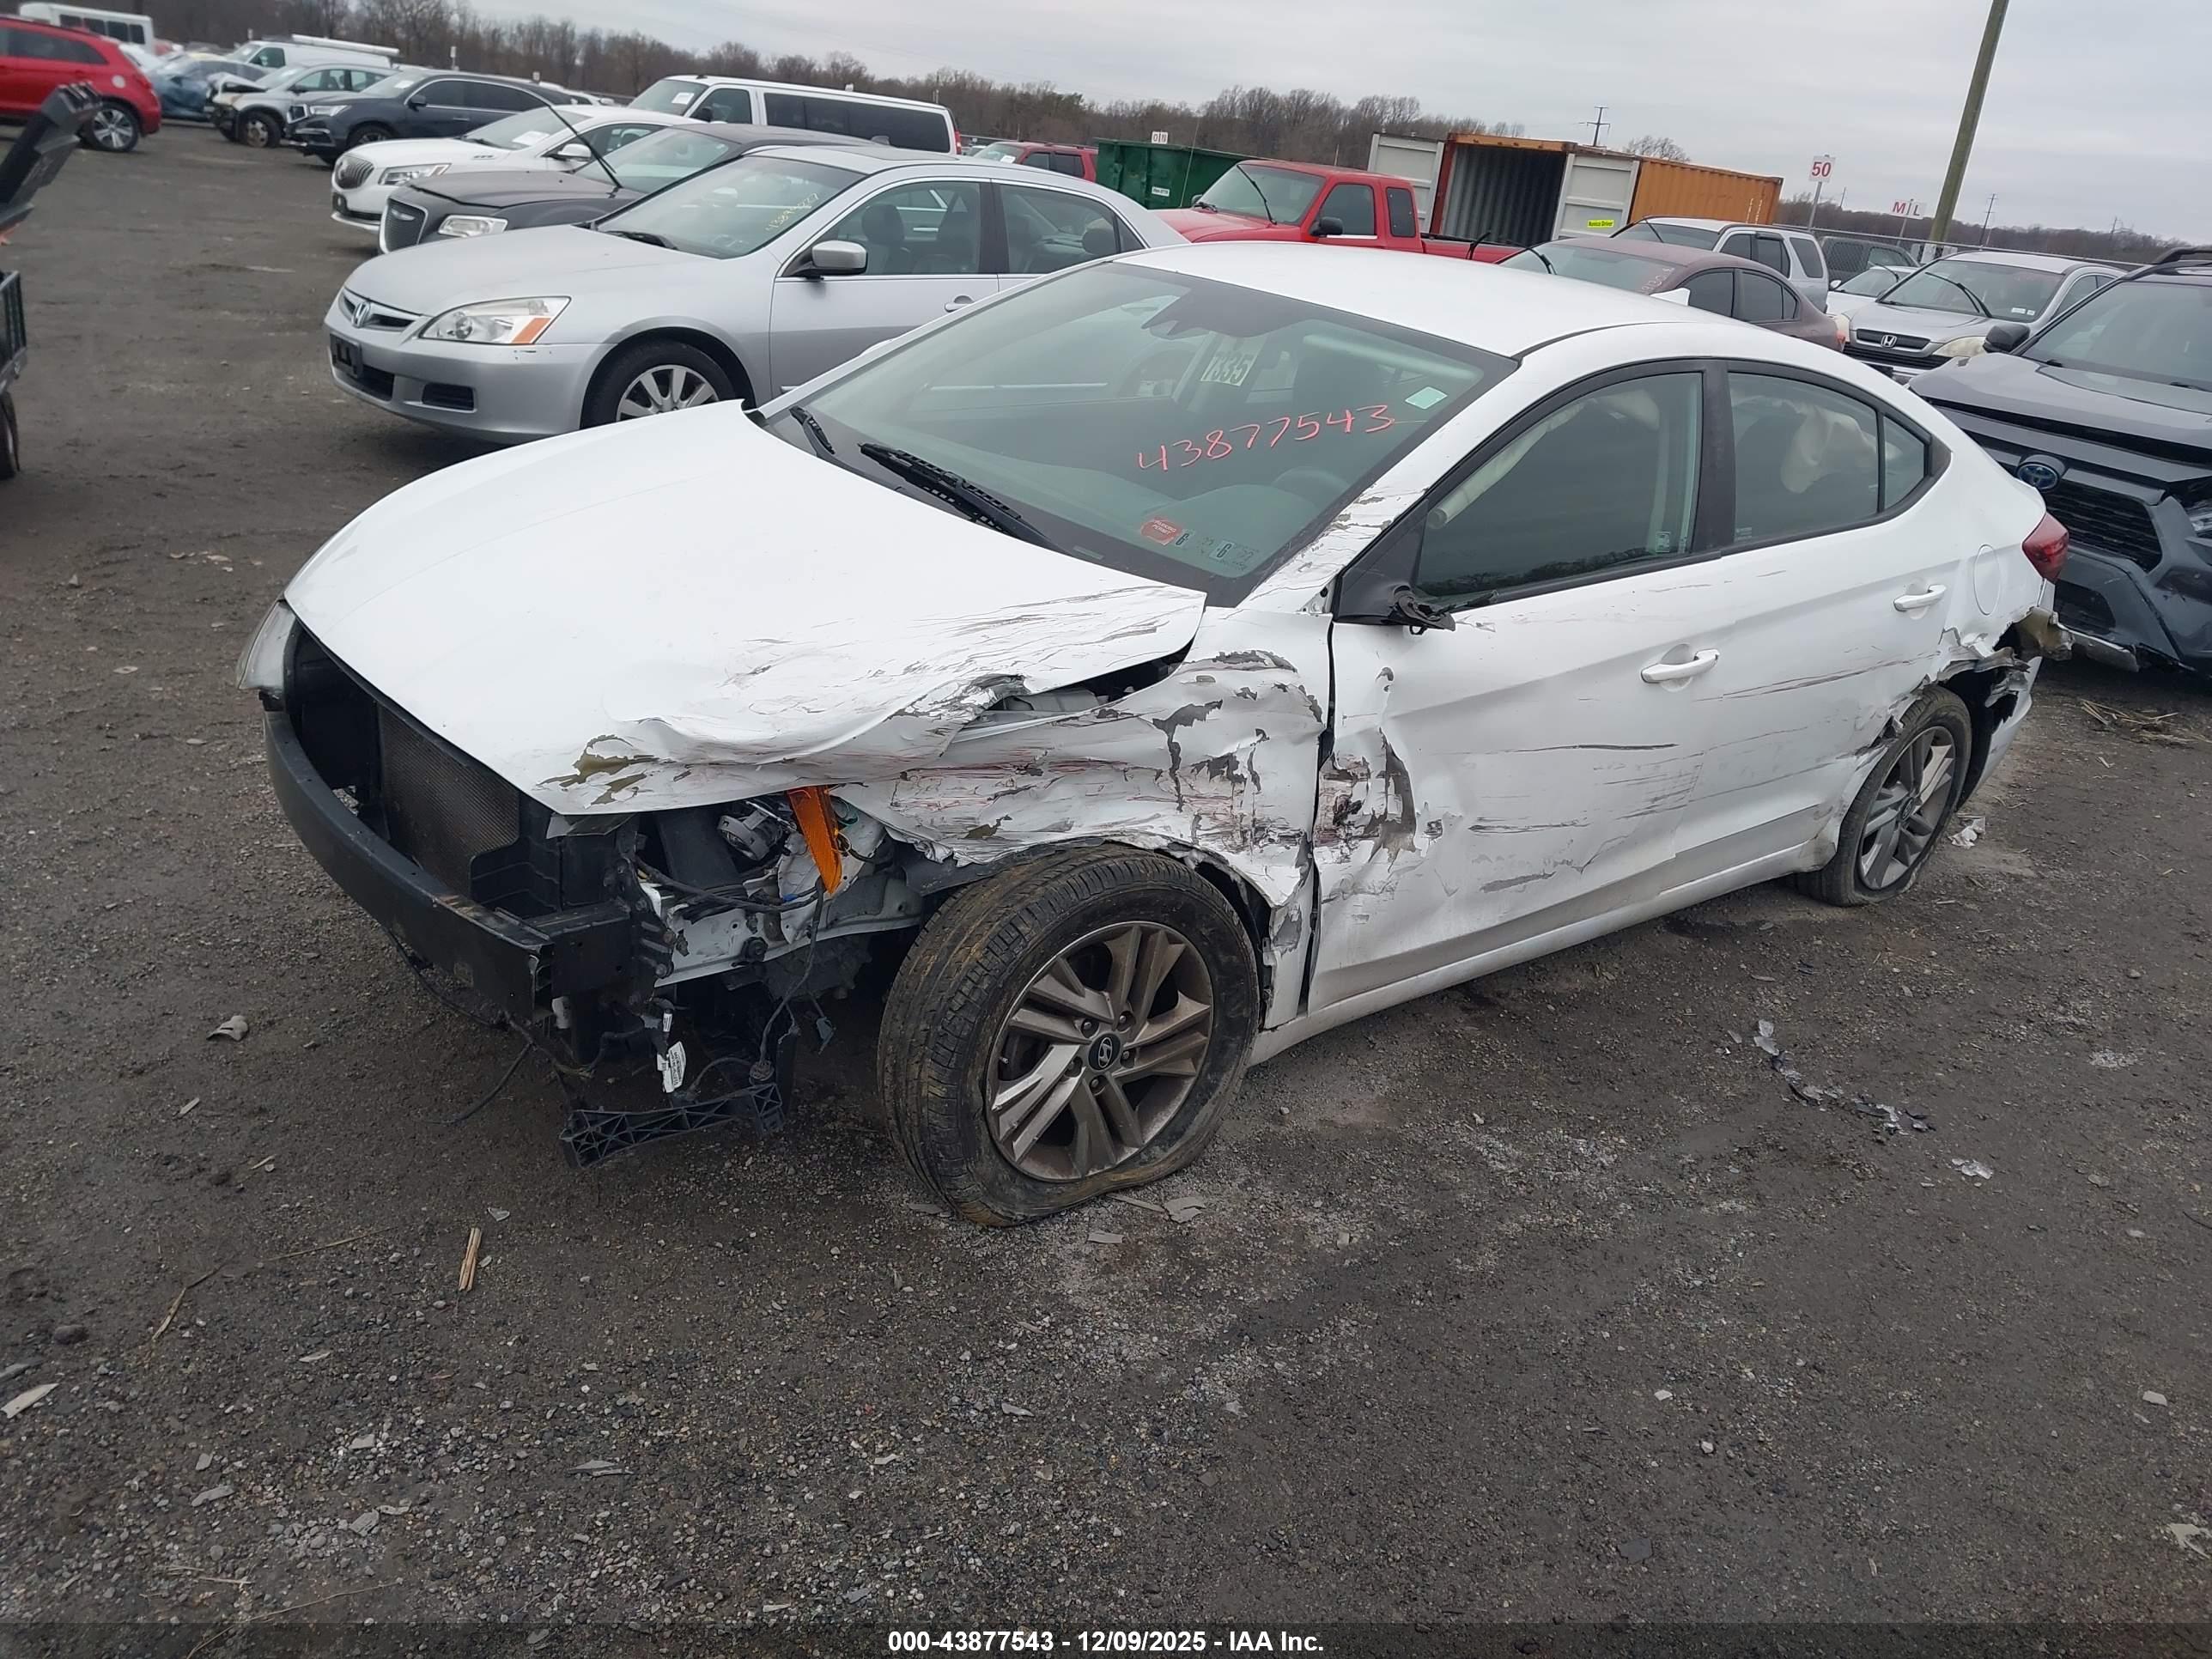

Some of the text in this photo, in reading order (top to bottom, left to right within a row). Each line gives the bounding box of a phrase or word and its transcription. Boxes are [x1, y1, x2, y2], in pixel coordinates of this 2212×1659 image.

[1811, 161, 1832, 178] 50
[1139, 404, 1395, 471] 43877543
[1175, 532, 1189, 545] 6
[1216, 543, 1232, 558] 6
